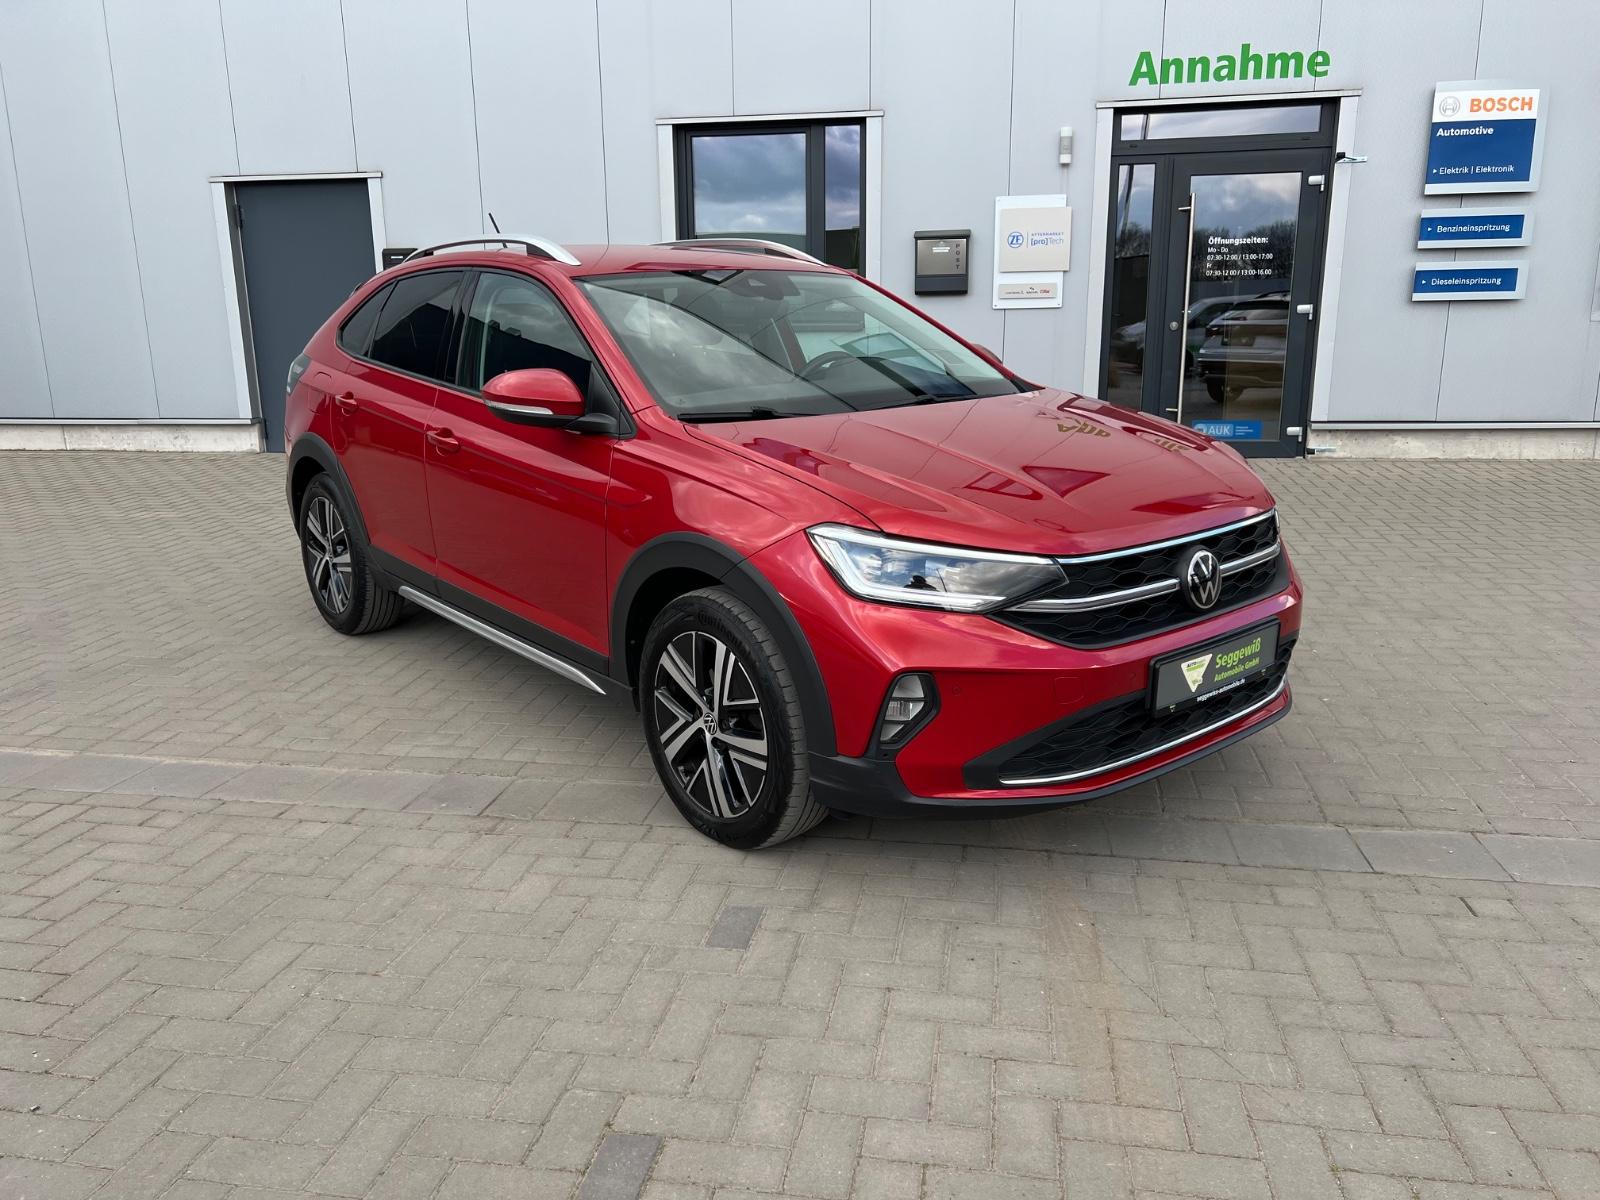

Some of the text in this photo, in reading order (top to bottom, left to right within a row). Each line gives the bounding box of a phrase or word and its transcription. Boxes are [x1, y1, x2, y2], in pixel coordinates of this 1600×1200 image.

[1128, 43, 1330, 86] Annahme
[1469, 96, 1533, 113] BOSCH
[1436, 126, 1494, 137] Automotive
[1439, 167, 1469, 175] Elektrik
[1475, 165, 1515, 174] Elektronik
[1436, 223, 1510, 233] Benzineinspritzung
[1009, 235, 1022, 246] ZF
[1208, 235, 1269, 246] Öffnungszeiten:
[1430, 276, 1502, 286] Dieseleinspritzung
[1207, 425, 1231, 435] AUK
[1215, 637, 1261, 668] Seggewiß
[1214, 657, 1260, 682] Automobile GmbH
